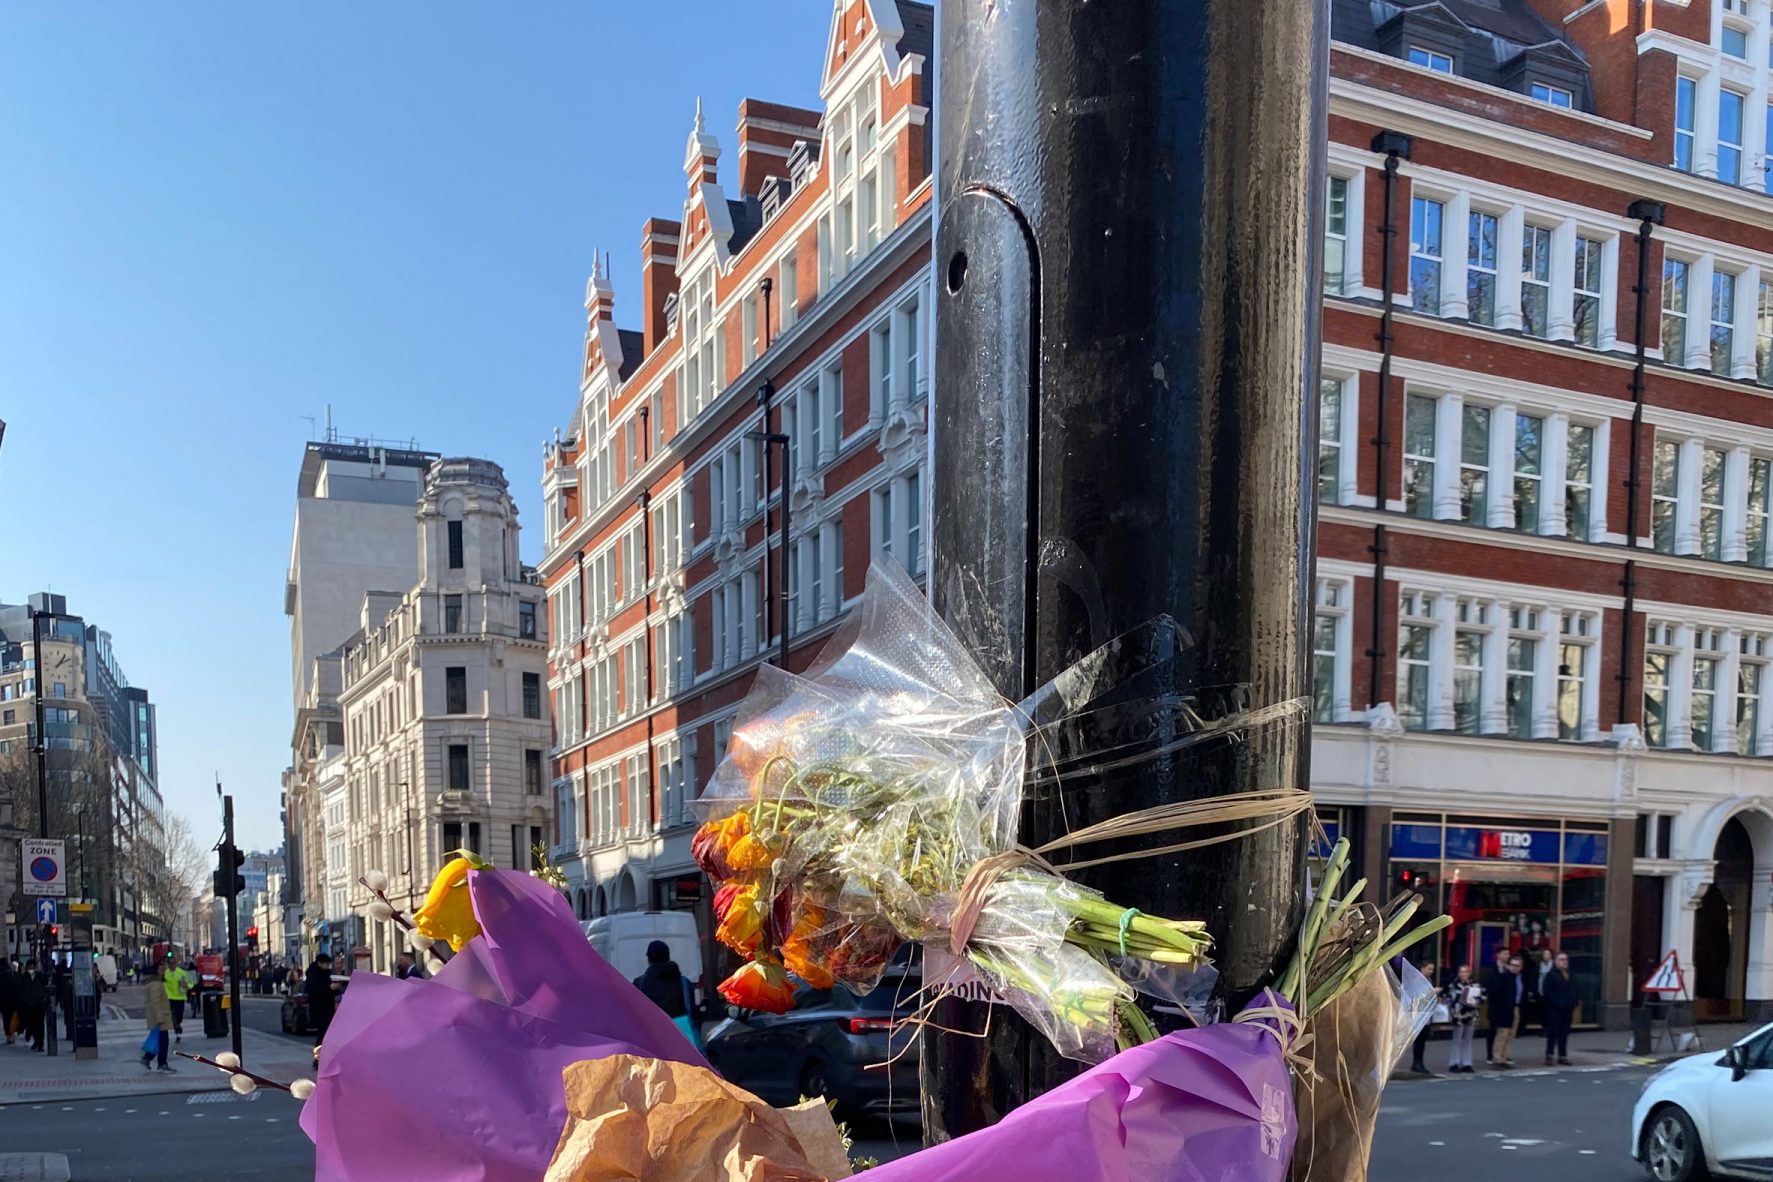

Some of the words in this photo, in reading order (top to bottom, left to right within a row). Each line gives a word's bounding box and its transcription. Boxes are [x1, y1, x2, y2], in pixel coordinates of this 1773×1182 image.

[1481, 831, 1532, 858] METRO
[30, 847, 57, 856] ZONE
[1501, 847, 1531, 859] BANK
